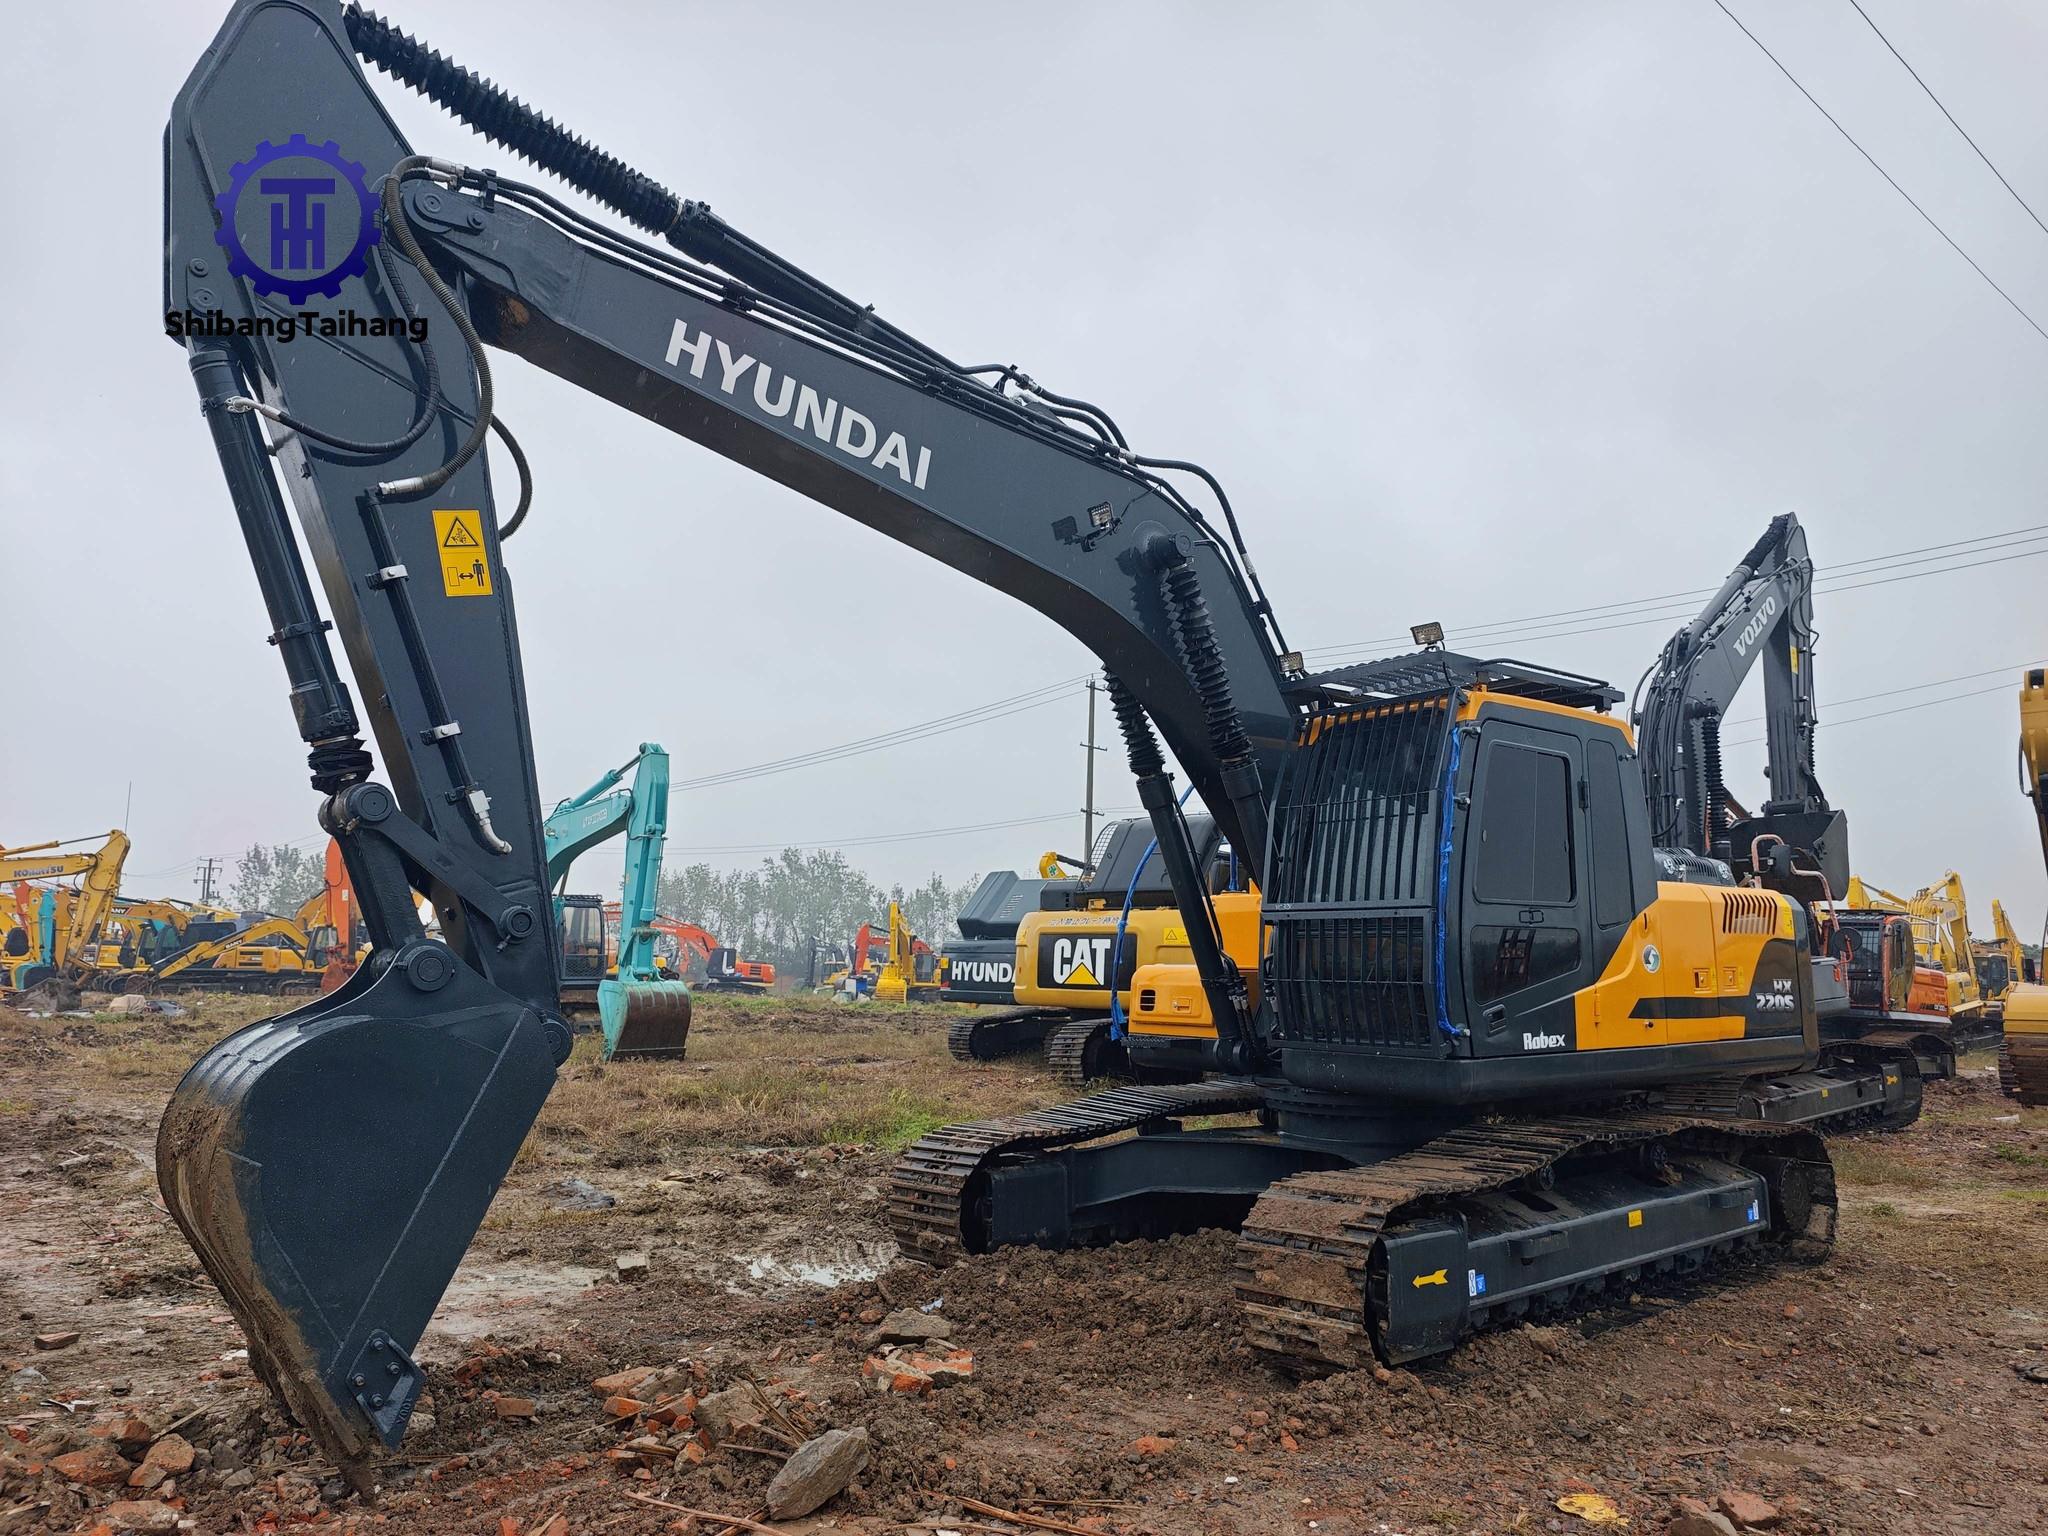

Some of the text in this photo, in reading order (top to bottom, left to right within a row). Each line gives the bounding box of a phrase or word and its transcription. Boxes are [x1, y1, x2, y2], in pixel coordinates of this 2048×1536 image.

[664, 318, 932, 490] HYUNDAI
[1733, 596, 1776, 657] VOLVO
[951, 960, 1016, 983] HYUND
[1053, 938, 1111, 986] CAT
[1772, 979, 1793, 994] HX
[1756, 993, 1795, 1012] 220S
[1523, 1030, 1566, 1050] Robex
